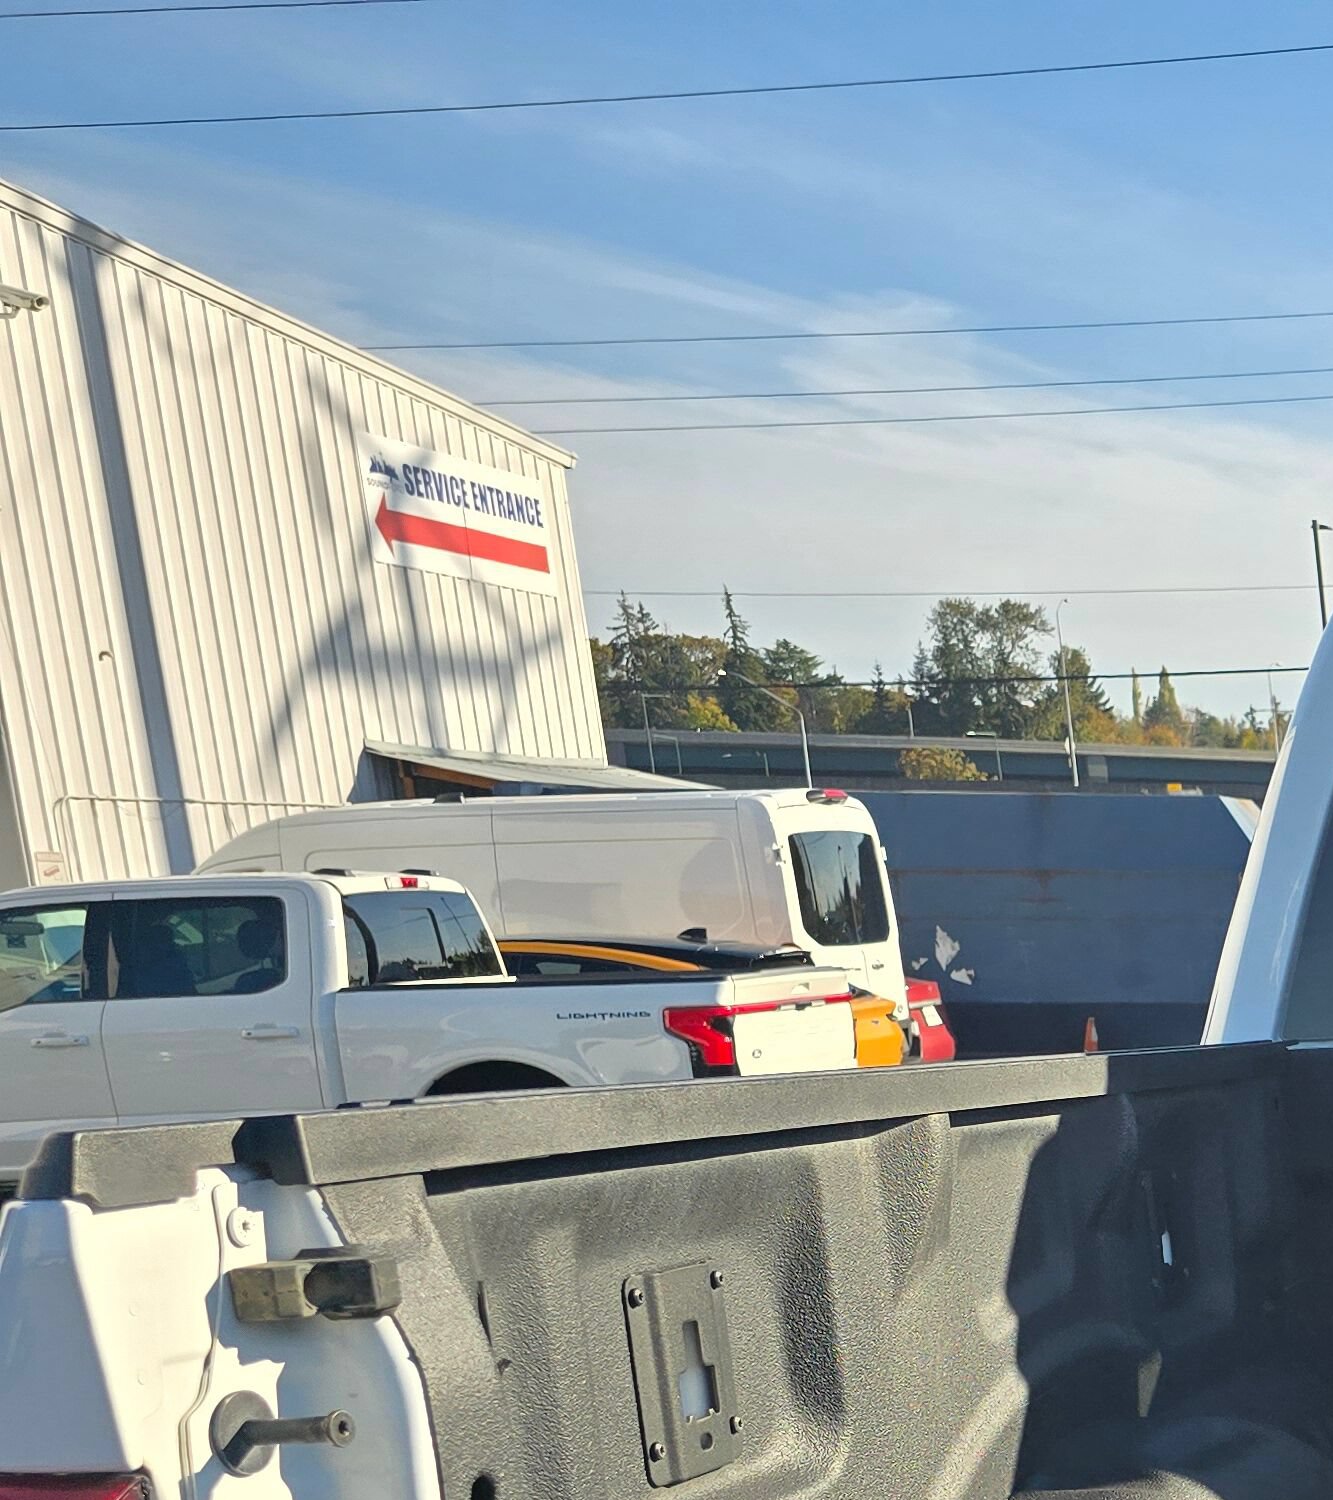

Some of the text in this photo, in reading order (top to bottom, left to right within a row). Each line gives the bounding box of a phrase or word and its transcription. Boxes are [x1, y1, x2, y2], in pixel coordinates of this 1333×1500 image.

[402, 463, 544, 529] SERVICE ENTRANCE
[556, 1010, 651, 1021] LIGHTNING
